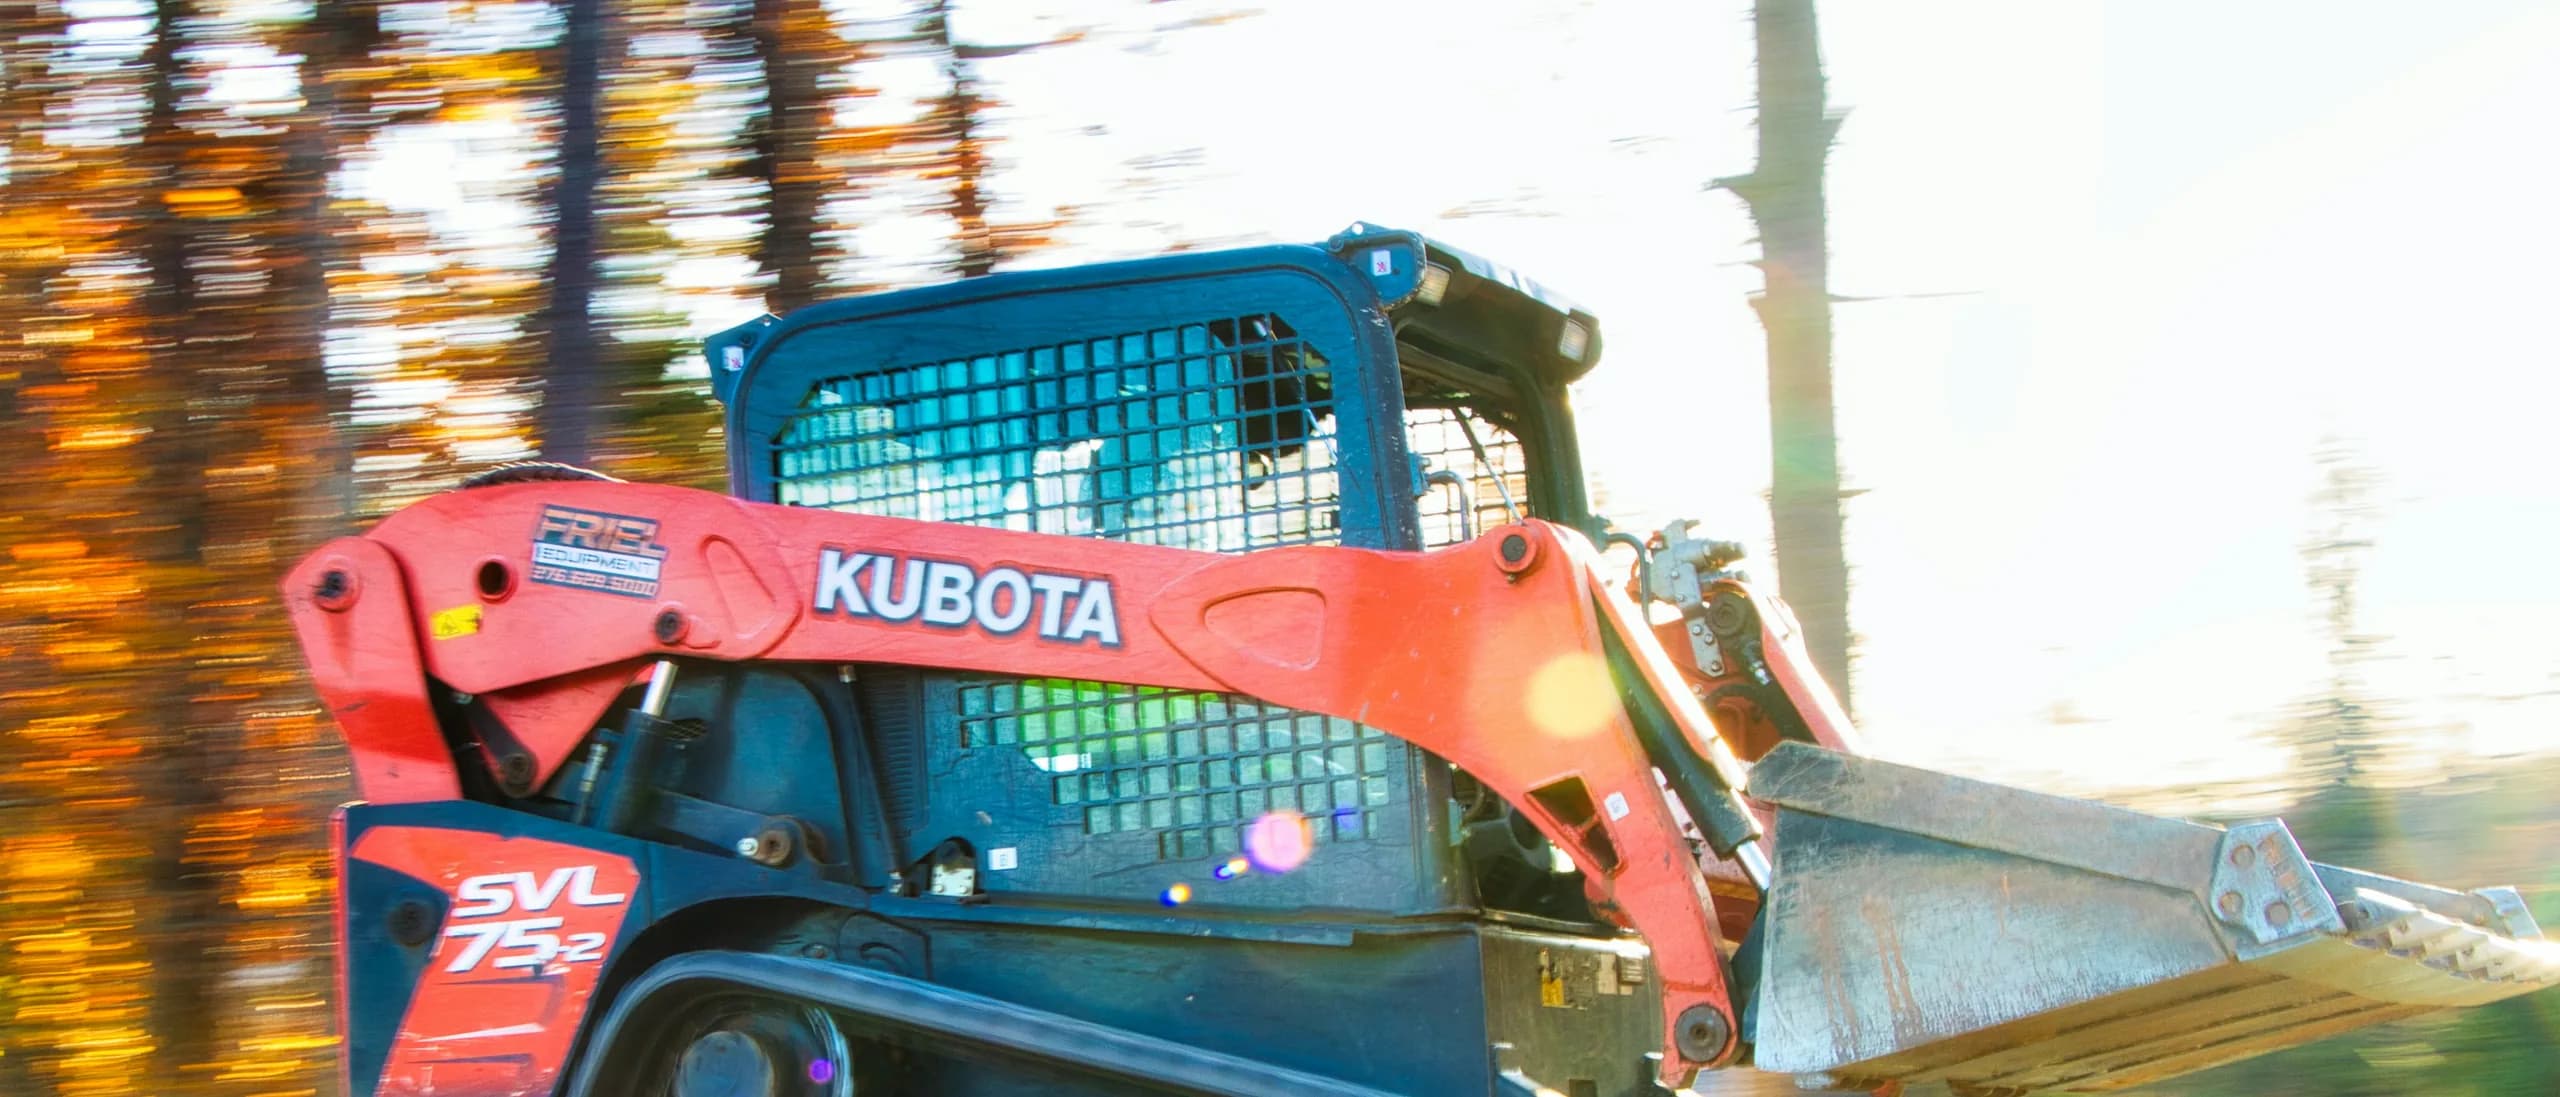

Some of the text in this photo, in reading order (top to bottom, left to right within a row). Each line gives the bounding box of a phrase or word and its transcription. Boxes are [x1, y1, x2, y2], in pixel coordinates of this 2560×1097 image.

[534, 508, 667, 559] FRIEL
[815, 549, 1120, 644] KUBOTA
[450, 865, 625, 917] SVL
[444, 917, 606, 973] 75-2
